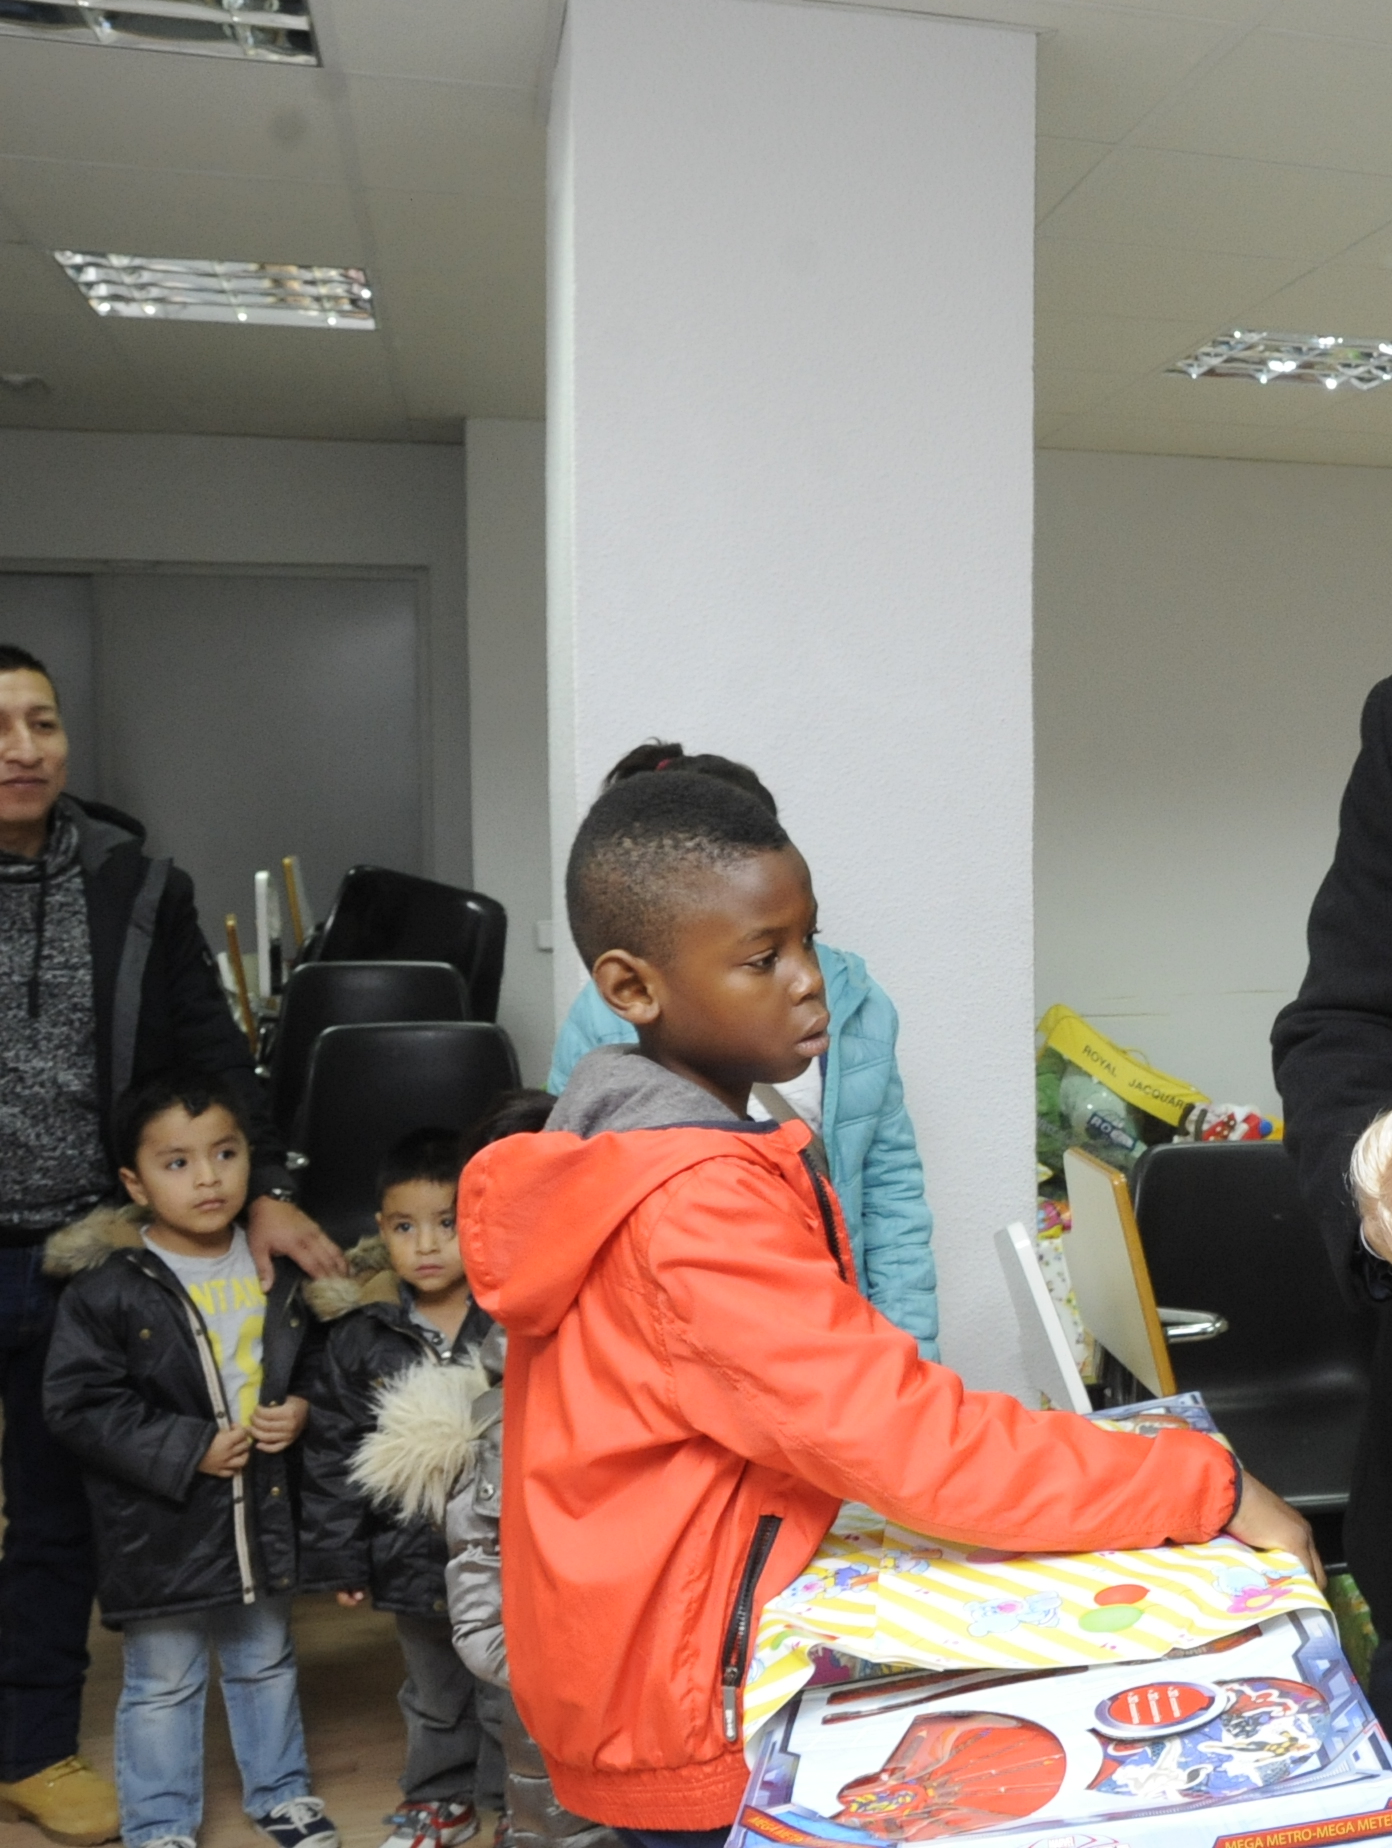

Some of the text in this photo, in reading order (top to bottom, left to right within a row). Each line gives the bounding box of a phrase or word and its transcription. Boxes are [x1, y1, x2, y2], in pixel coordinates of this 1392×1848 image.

[1083, 1045, 1186, 1109] ROYAL JACQUAR
[189, 1277, 267, 1316] NTAN
[1266, 1822, 1356, 1847] METRO-MEGA
